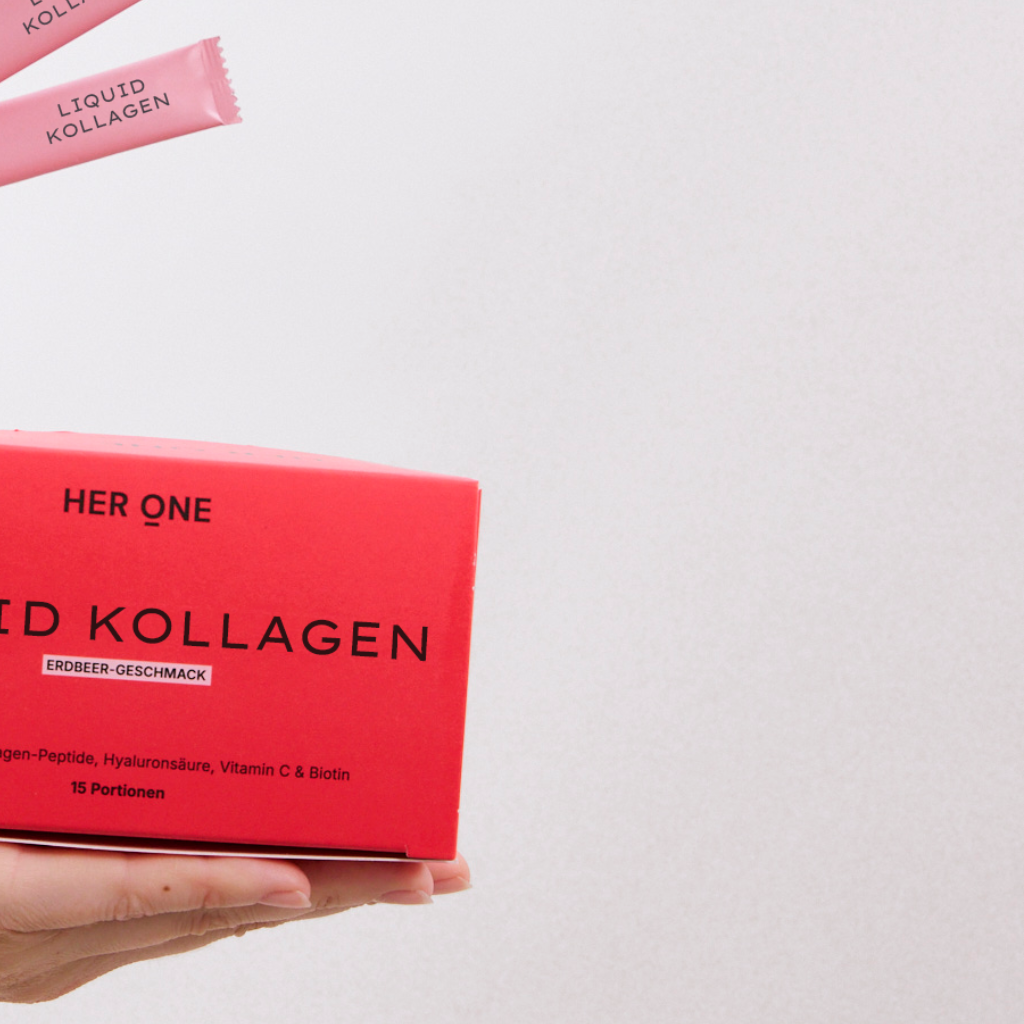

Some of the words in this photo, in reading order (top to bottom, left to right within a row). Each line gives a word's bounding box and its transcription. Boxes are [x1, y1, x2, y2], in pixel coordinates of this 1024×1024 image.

[57, 78, 145, 117] LIQUID
[46, 91, 170, 145] KOLLAGEN
[63, 488, 128, 517] HER
[140, 493, 212, 527] ONE
[89, 605, 429, 662] KOLLAGEN
[46, 659, 206, 681] ERDBEER-GESCHMACK
[103, 752, 215, 775] Hyaluronsäure,
[220, 760, 275, 776] Vitamin
[279, 764, 291, 778] C
[294, 765, 305, 779] &
[309, 765, 350, 781] Biotin
[70, 780, 87, 795] 15
[90, 781, 165, 800] Portionen
